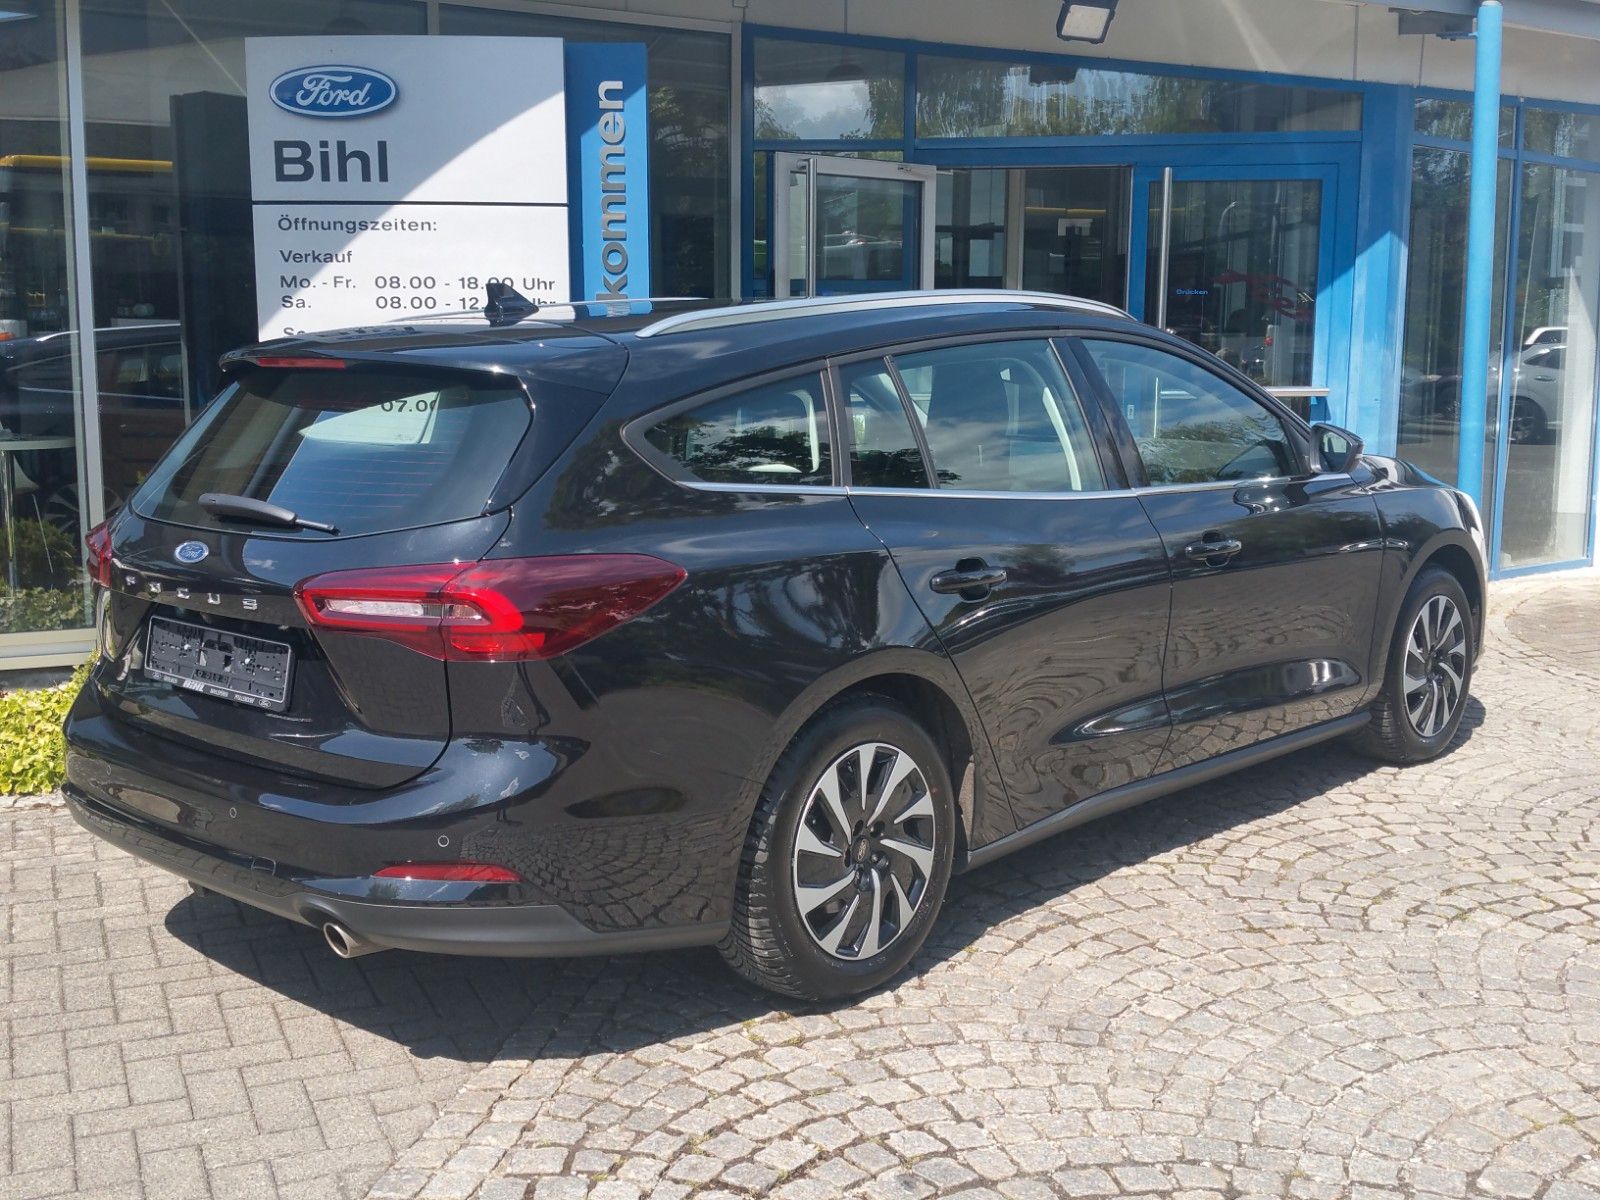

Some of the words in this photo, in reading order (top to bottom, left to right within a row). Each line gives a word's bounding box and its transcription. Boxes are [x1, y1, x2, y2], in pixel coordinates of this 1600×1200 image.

[296, 74, 373, 107] Ford
[274, 140, 389, 183] Bihl
[278, 214, 438, 234] Öffnungszeiten:
[279, 250, 353, 264] Verkauf
[279, 275, 316, 289] Mo.
[333, 276, 357, 289] Fr.
[374, 275, 437, 290] 08.00
[523, 277, 556, 291] Uhr
[281, 295, 312, 309] Sa.
[375, 296, 437, 310] 08.00
[458, 297, 485, 311] 12.
